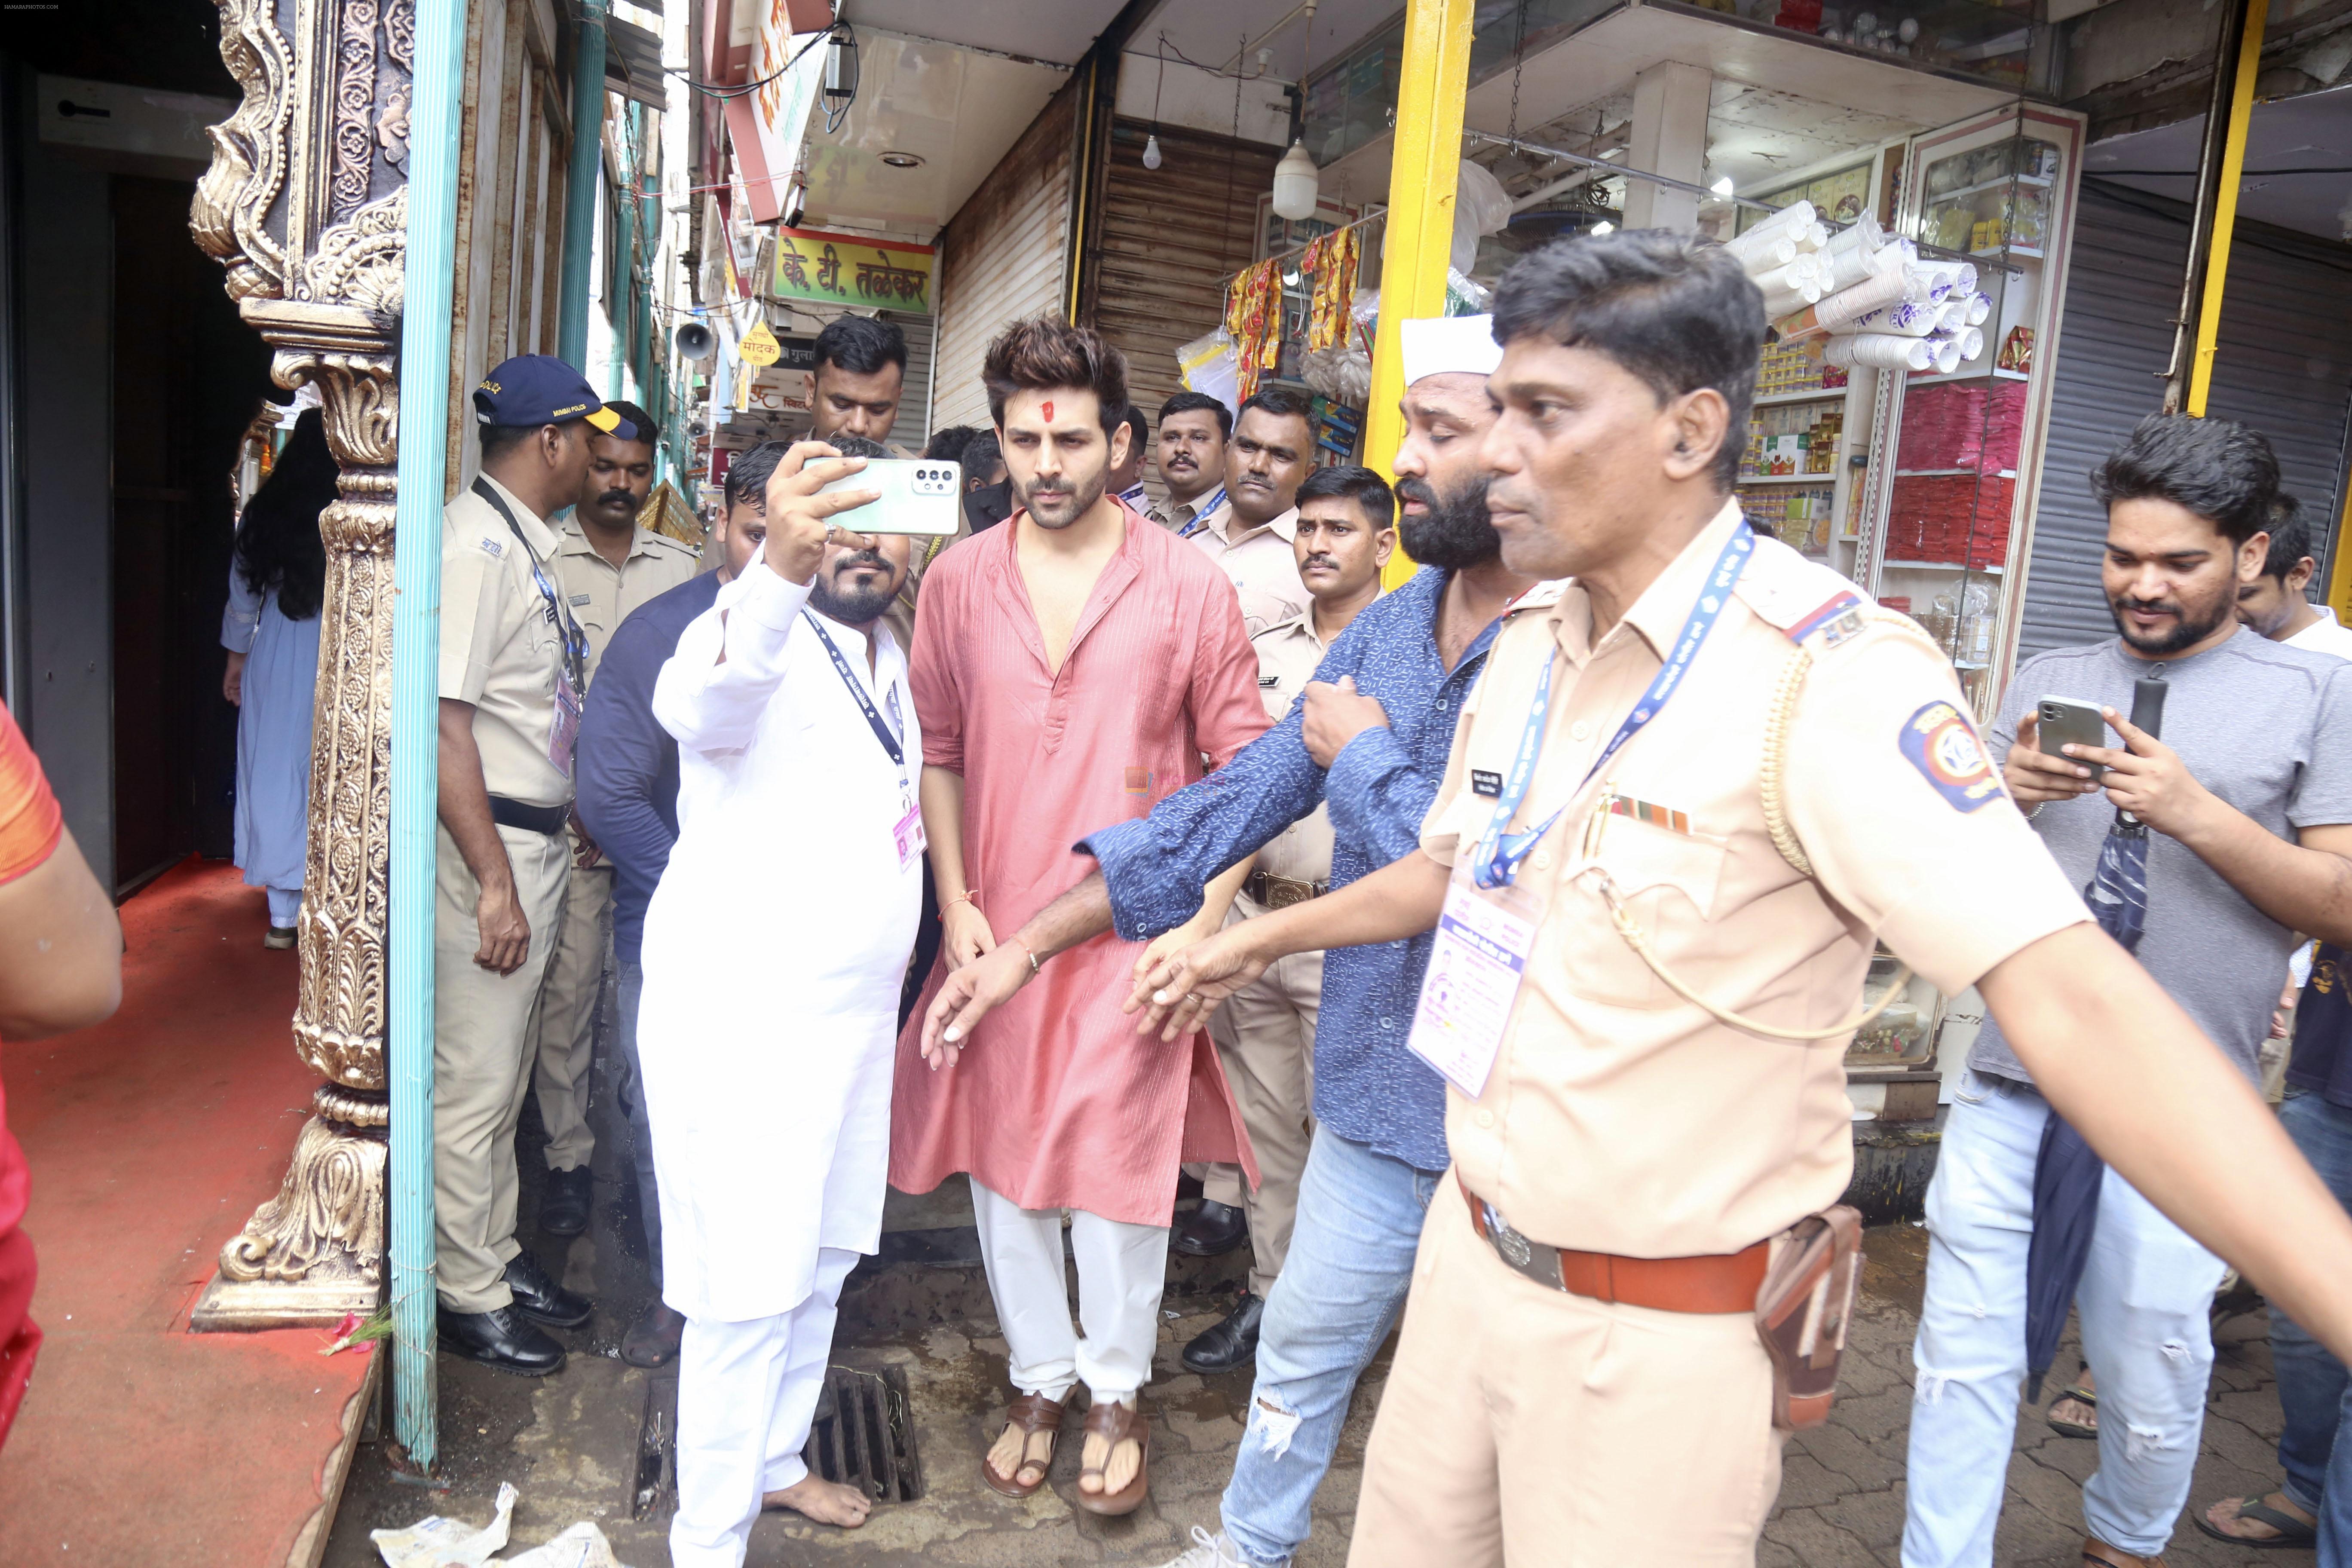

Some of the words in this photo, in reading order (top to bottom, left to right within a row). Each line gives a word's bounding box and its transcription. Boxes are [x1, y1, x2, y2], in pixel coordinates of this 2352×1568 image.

[782, 237, 811, 292] के.
[817, 243, 846, 296] टी.
[855, 249, 928, 306] तळेकर
[742, 338, 776, 354] मोदक
[790, 349, 815, 362] गुला
[553, 407, 571, 417] MUMBAI
[571, 404, 586, 413] POLICE
